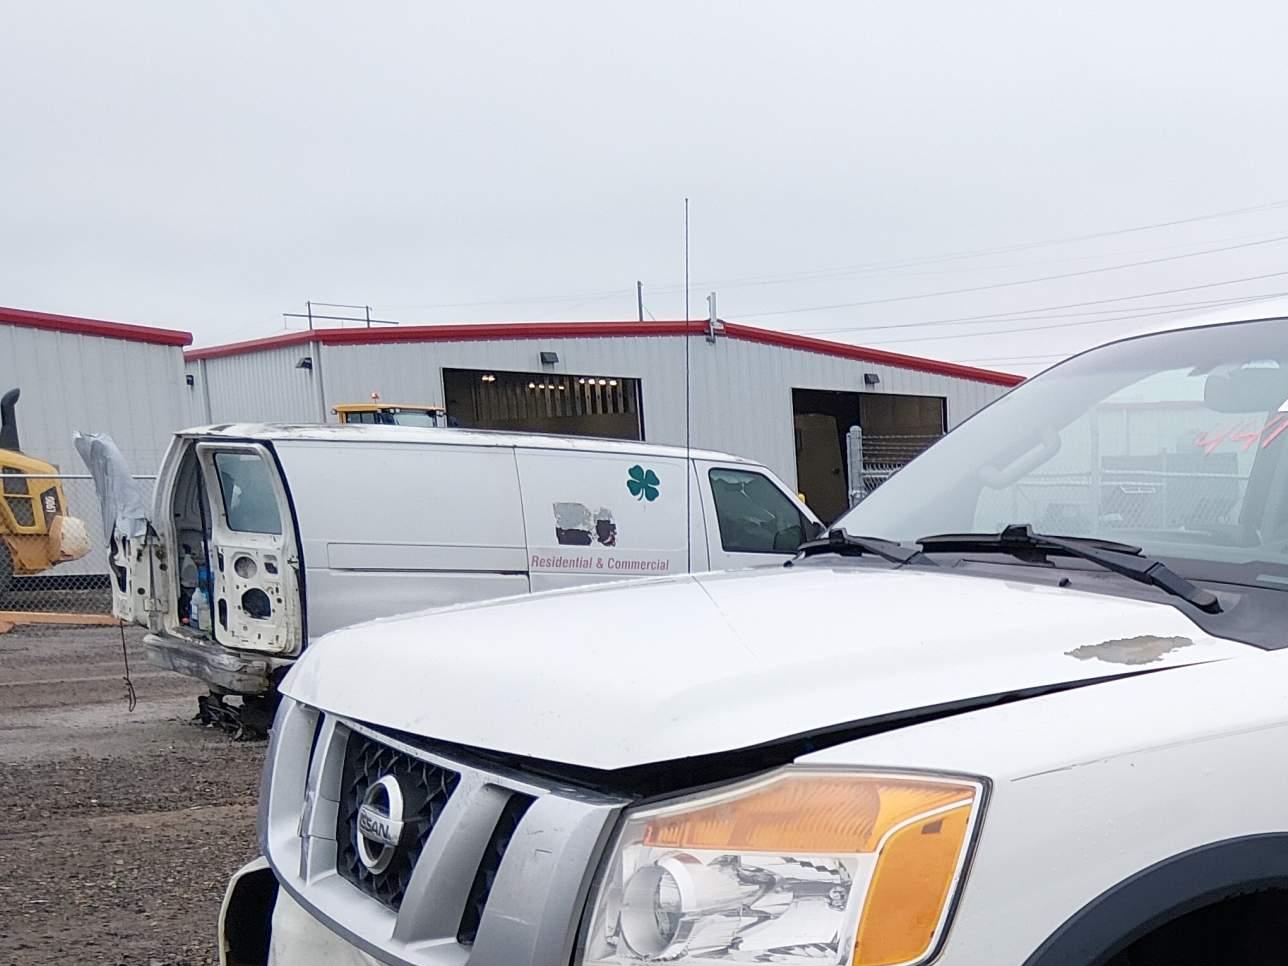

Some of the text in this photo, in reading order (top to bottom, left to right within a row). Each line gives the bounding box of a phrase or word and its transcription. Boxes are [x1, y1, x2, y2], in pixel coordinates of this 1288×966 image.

[530, 554, 670, 571] Residential & Commercial
